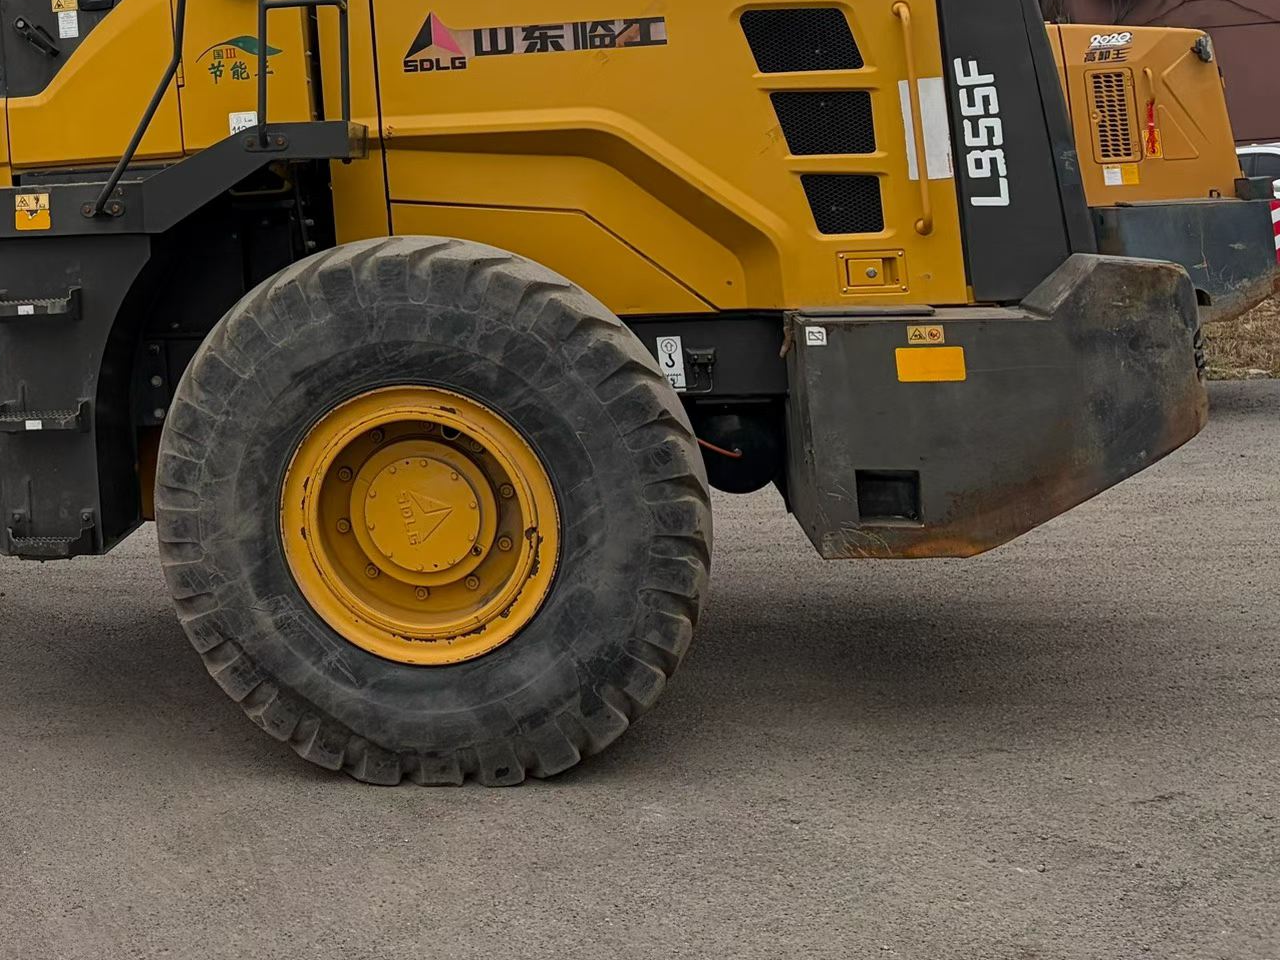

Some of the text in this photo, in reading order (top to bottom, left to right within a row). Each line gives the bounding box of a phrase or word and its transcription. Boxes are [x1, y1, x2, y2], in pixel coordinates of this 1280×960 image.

[473, 16, 668, 57] 山东临工
[1090, 31, 1132, 46] 2020
[404, 56, 467, 73] SDLG
[953, 57, 1010, 206] L955F
